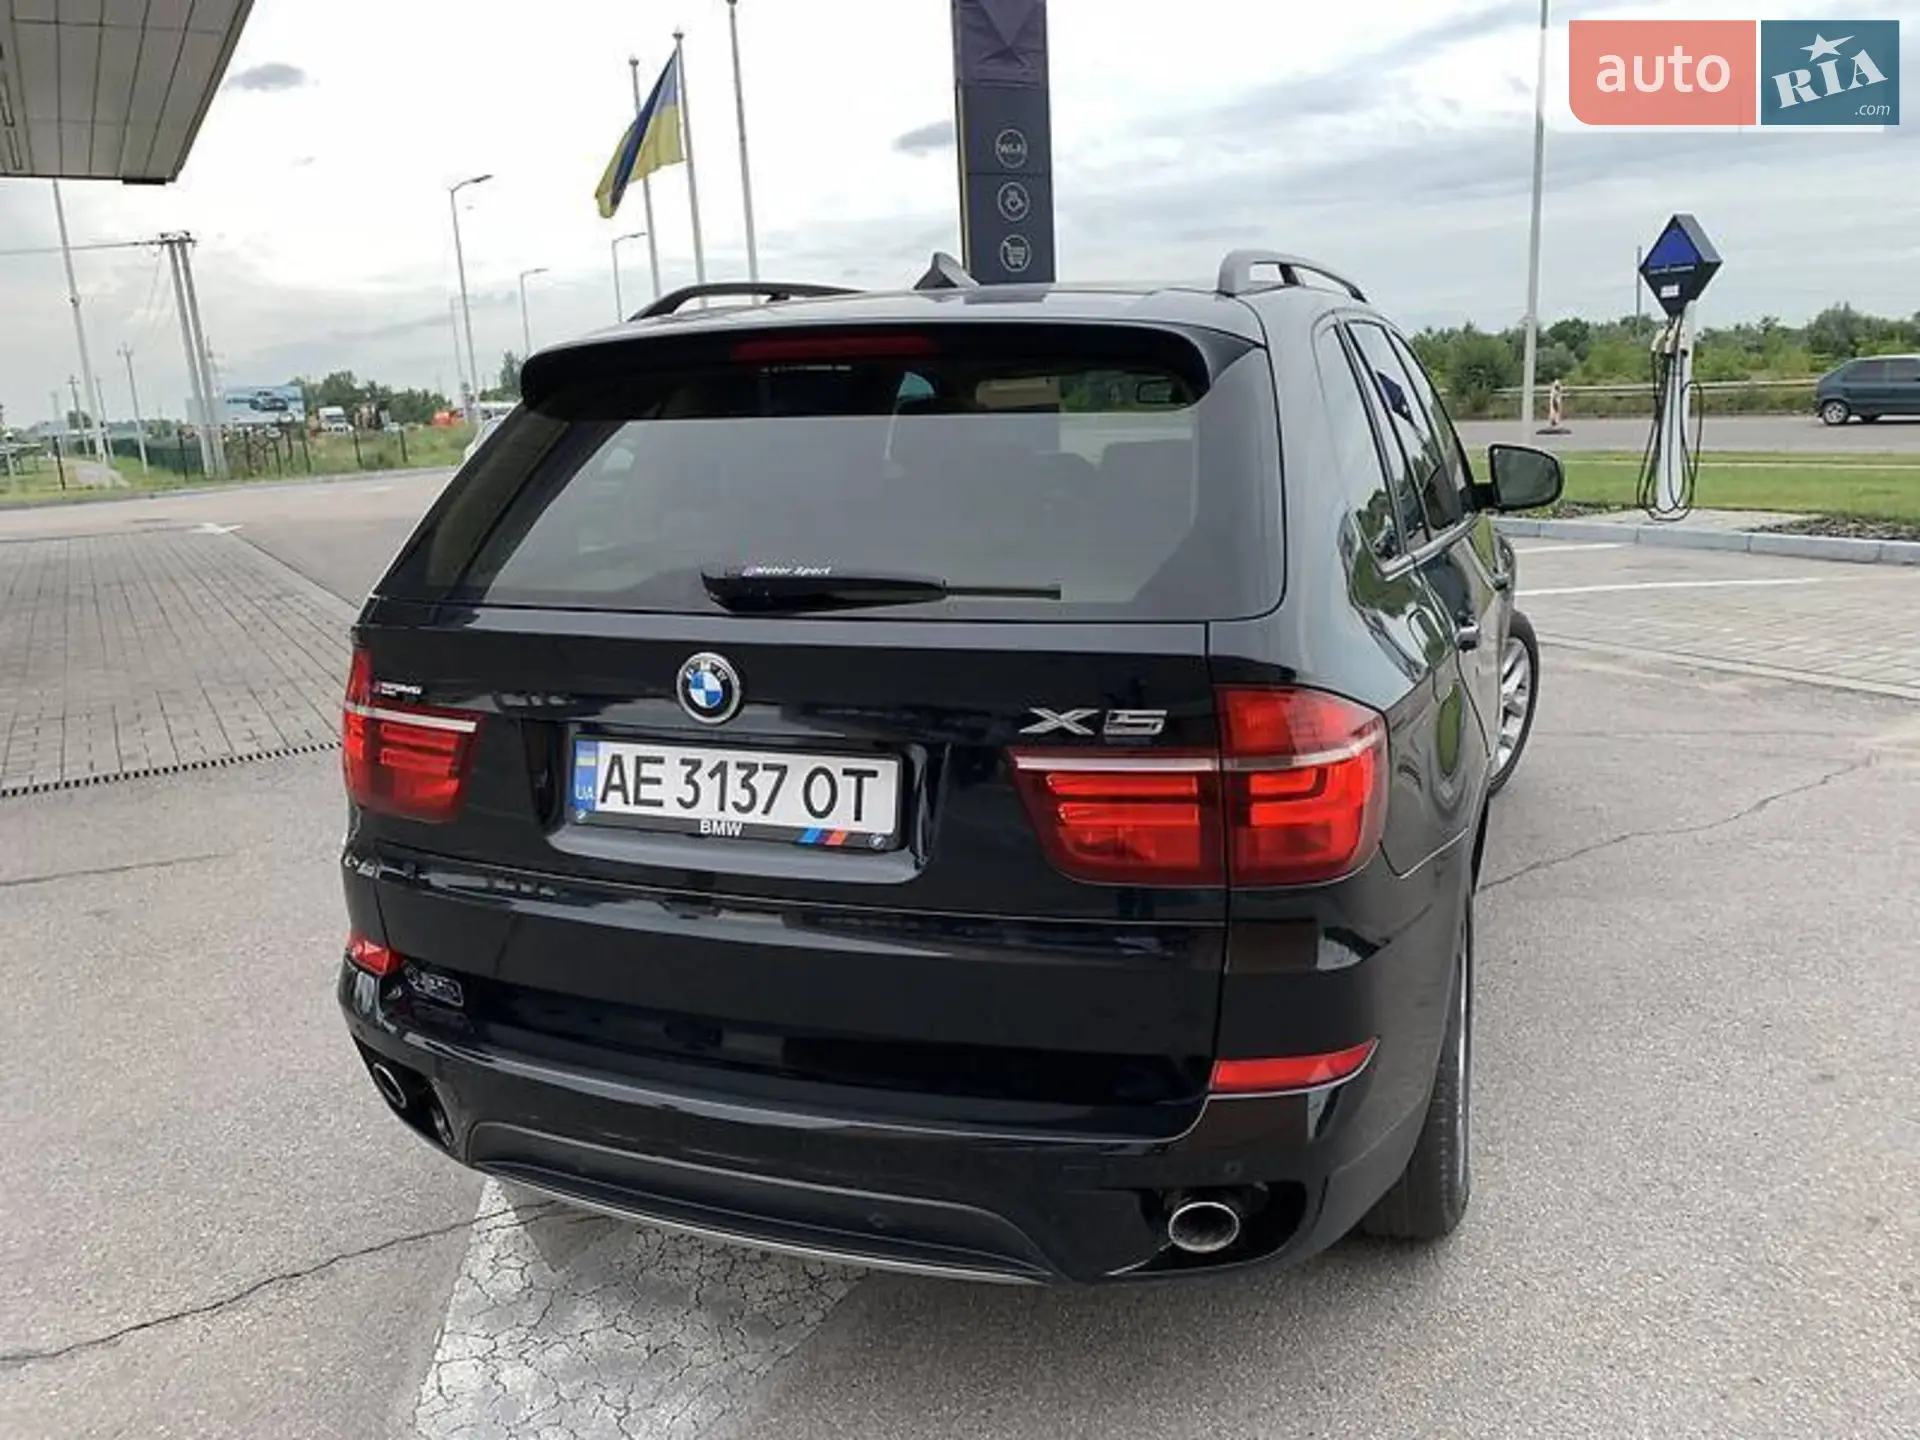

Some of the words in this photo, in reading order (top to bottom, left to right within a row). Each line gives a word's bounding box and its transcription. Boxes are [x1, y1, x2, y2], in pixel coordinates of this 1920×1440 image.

[1018, 706, 1168, 736] X5
[574, 784, 595, 801] UA
[600, 753, 665, 808] AE
[676, 757, 788, 815] 3137
[803, 765, 879, 822] OT
[699, 819, 743, 837] BMW
